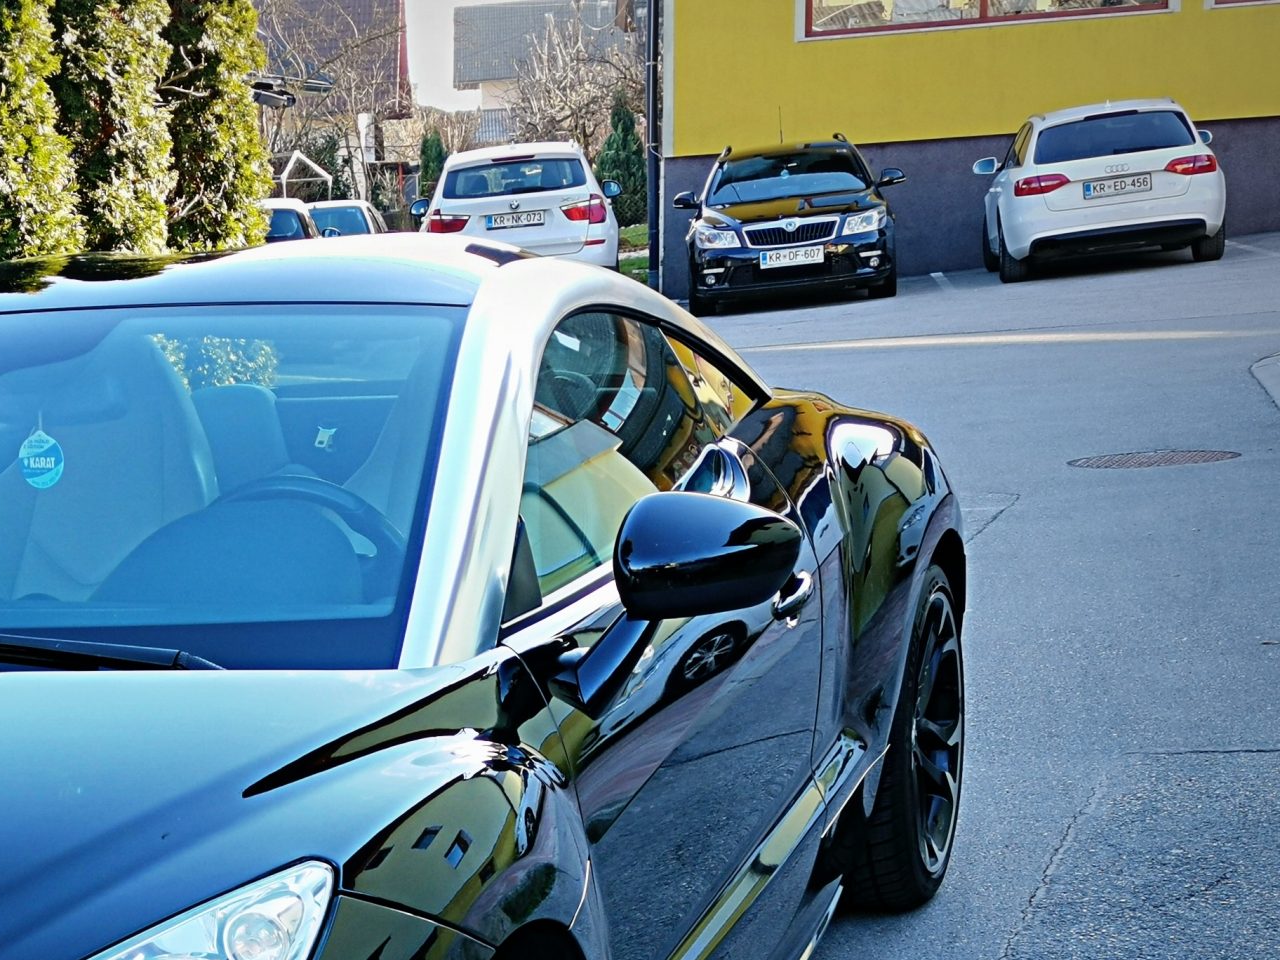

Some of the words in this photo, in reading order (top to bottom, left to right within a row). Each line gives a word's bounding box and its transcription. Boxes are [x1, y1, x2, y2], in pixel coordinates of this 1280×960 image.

[1092, 183, 1106, 194] KR
[1113, 176, 1148, 191] ED-456
[493, 215, 506, 226] KR
[511, 212, 542, 224] NK-073
[768, 252, 782, 263] KR
[788, 247, 820, 261] DF-607
[29, 456, 56, 469] KARAT
